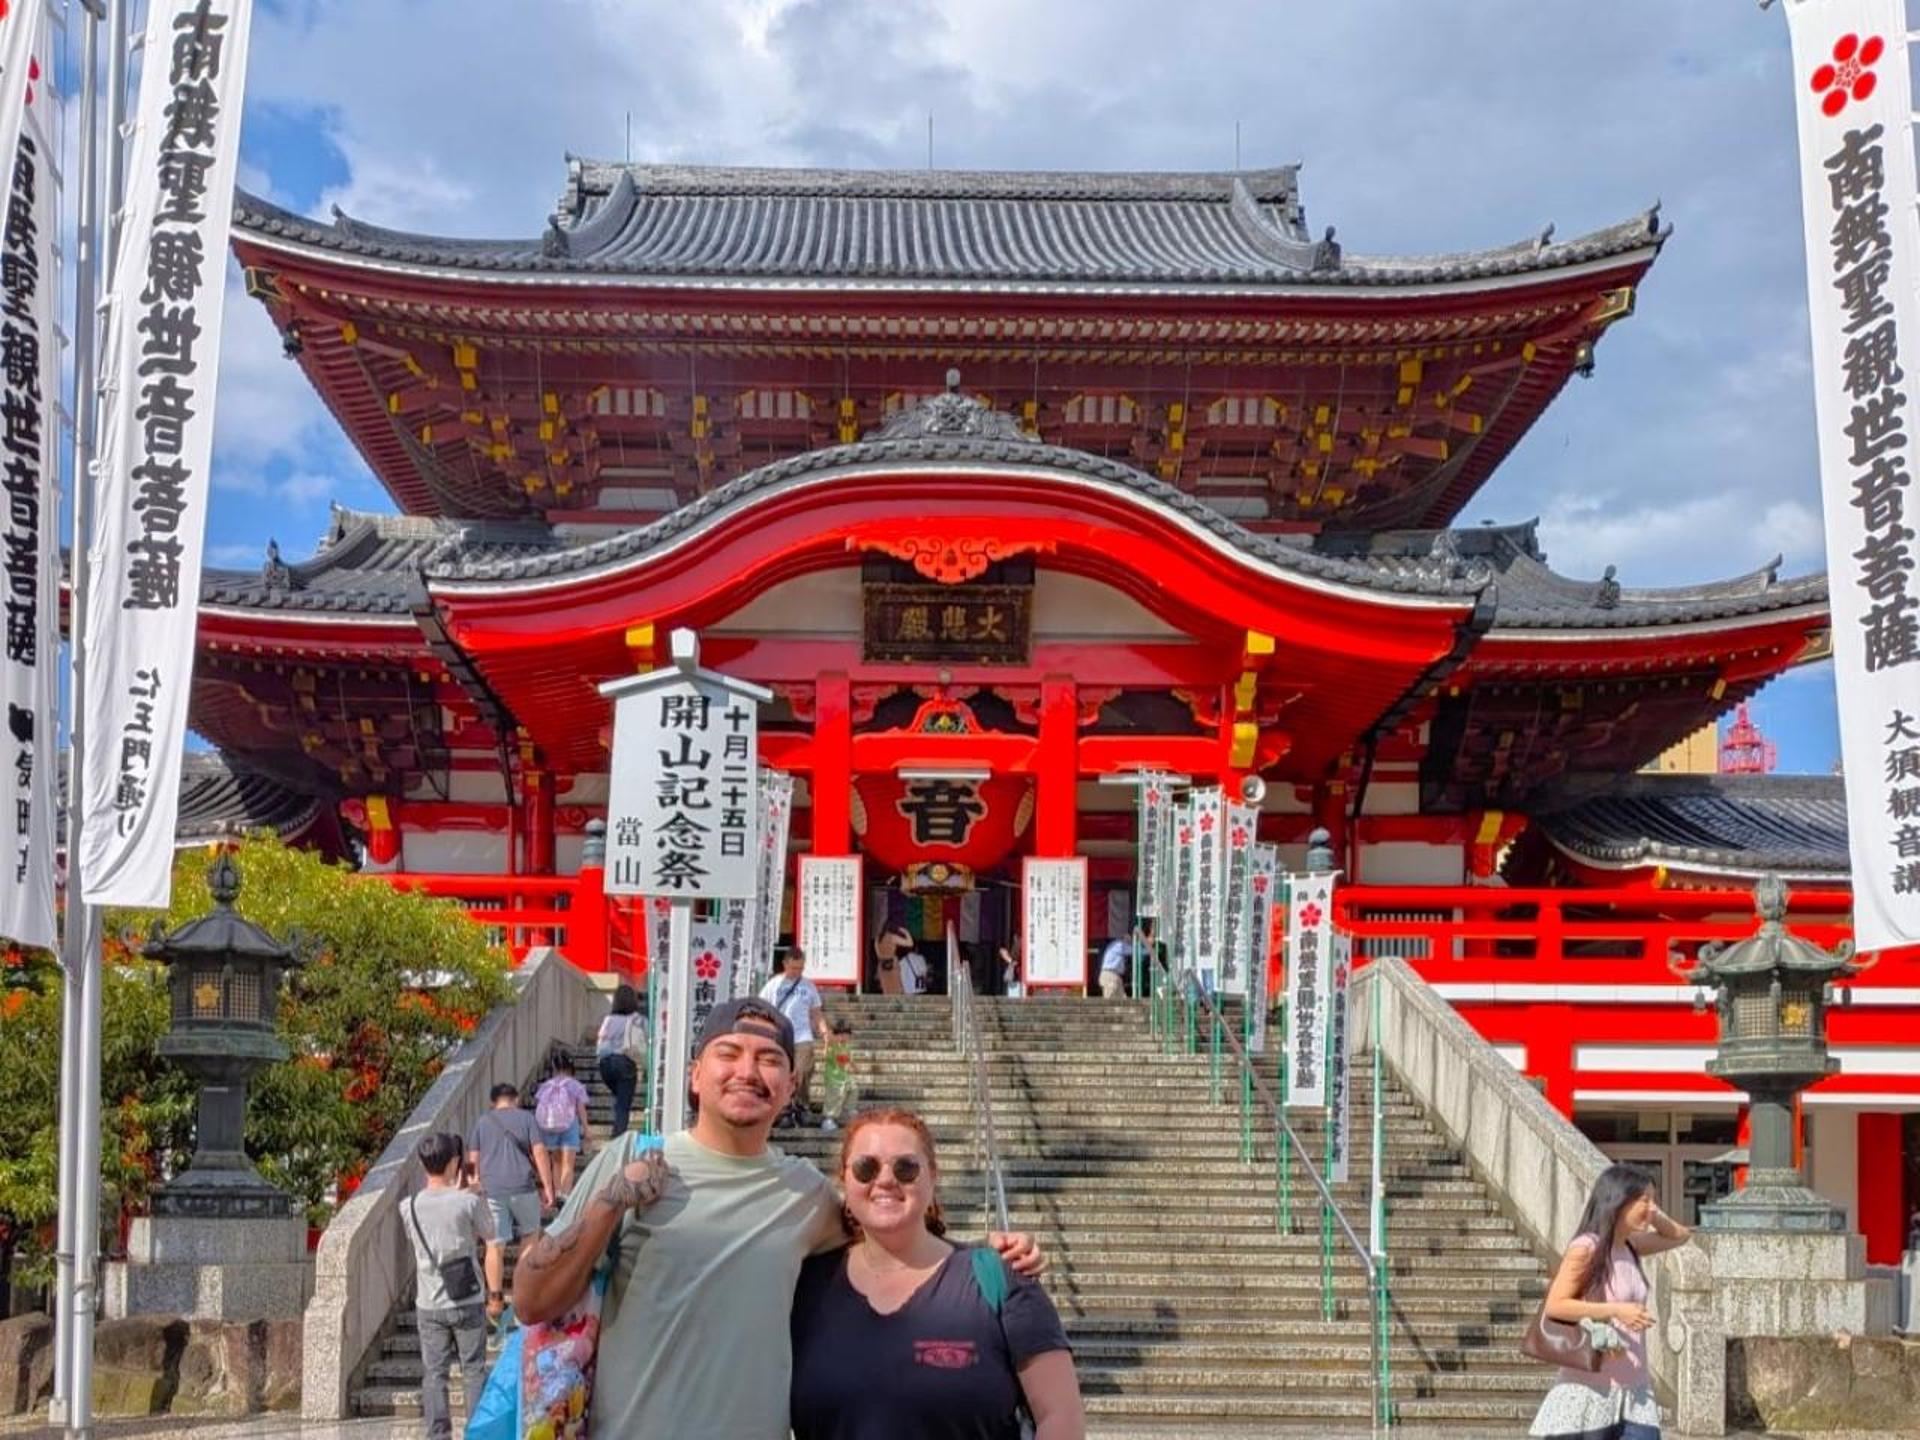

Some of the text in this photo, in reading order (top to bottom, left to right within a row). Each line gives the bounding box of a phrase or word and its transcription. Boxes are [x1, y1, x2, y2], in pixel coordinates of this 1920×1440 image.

[1823, 123, 1920, 673] 南無聖観世音菩薩
[653, 695, 713, 889] 開山記念祭
[720, 705, 749, 857] 十月二十五日
[899, 778, 985, 845] 音
